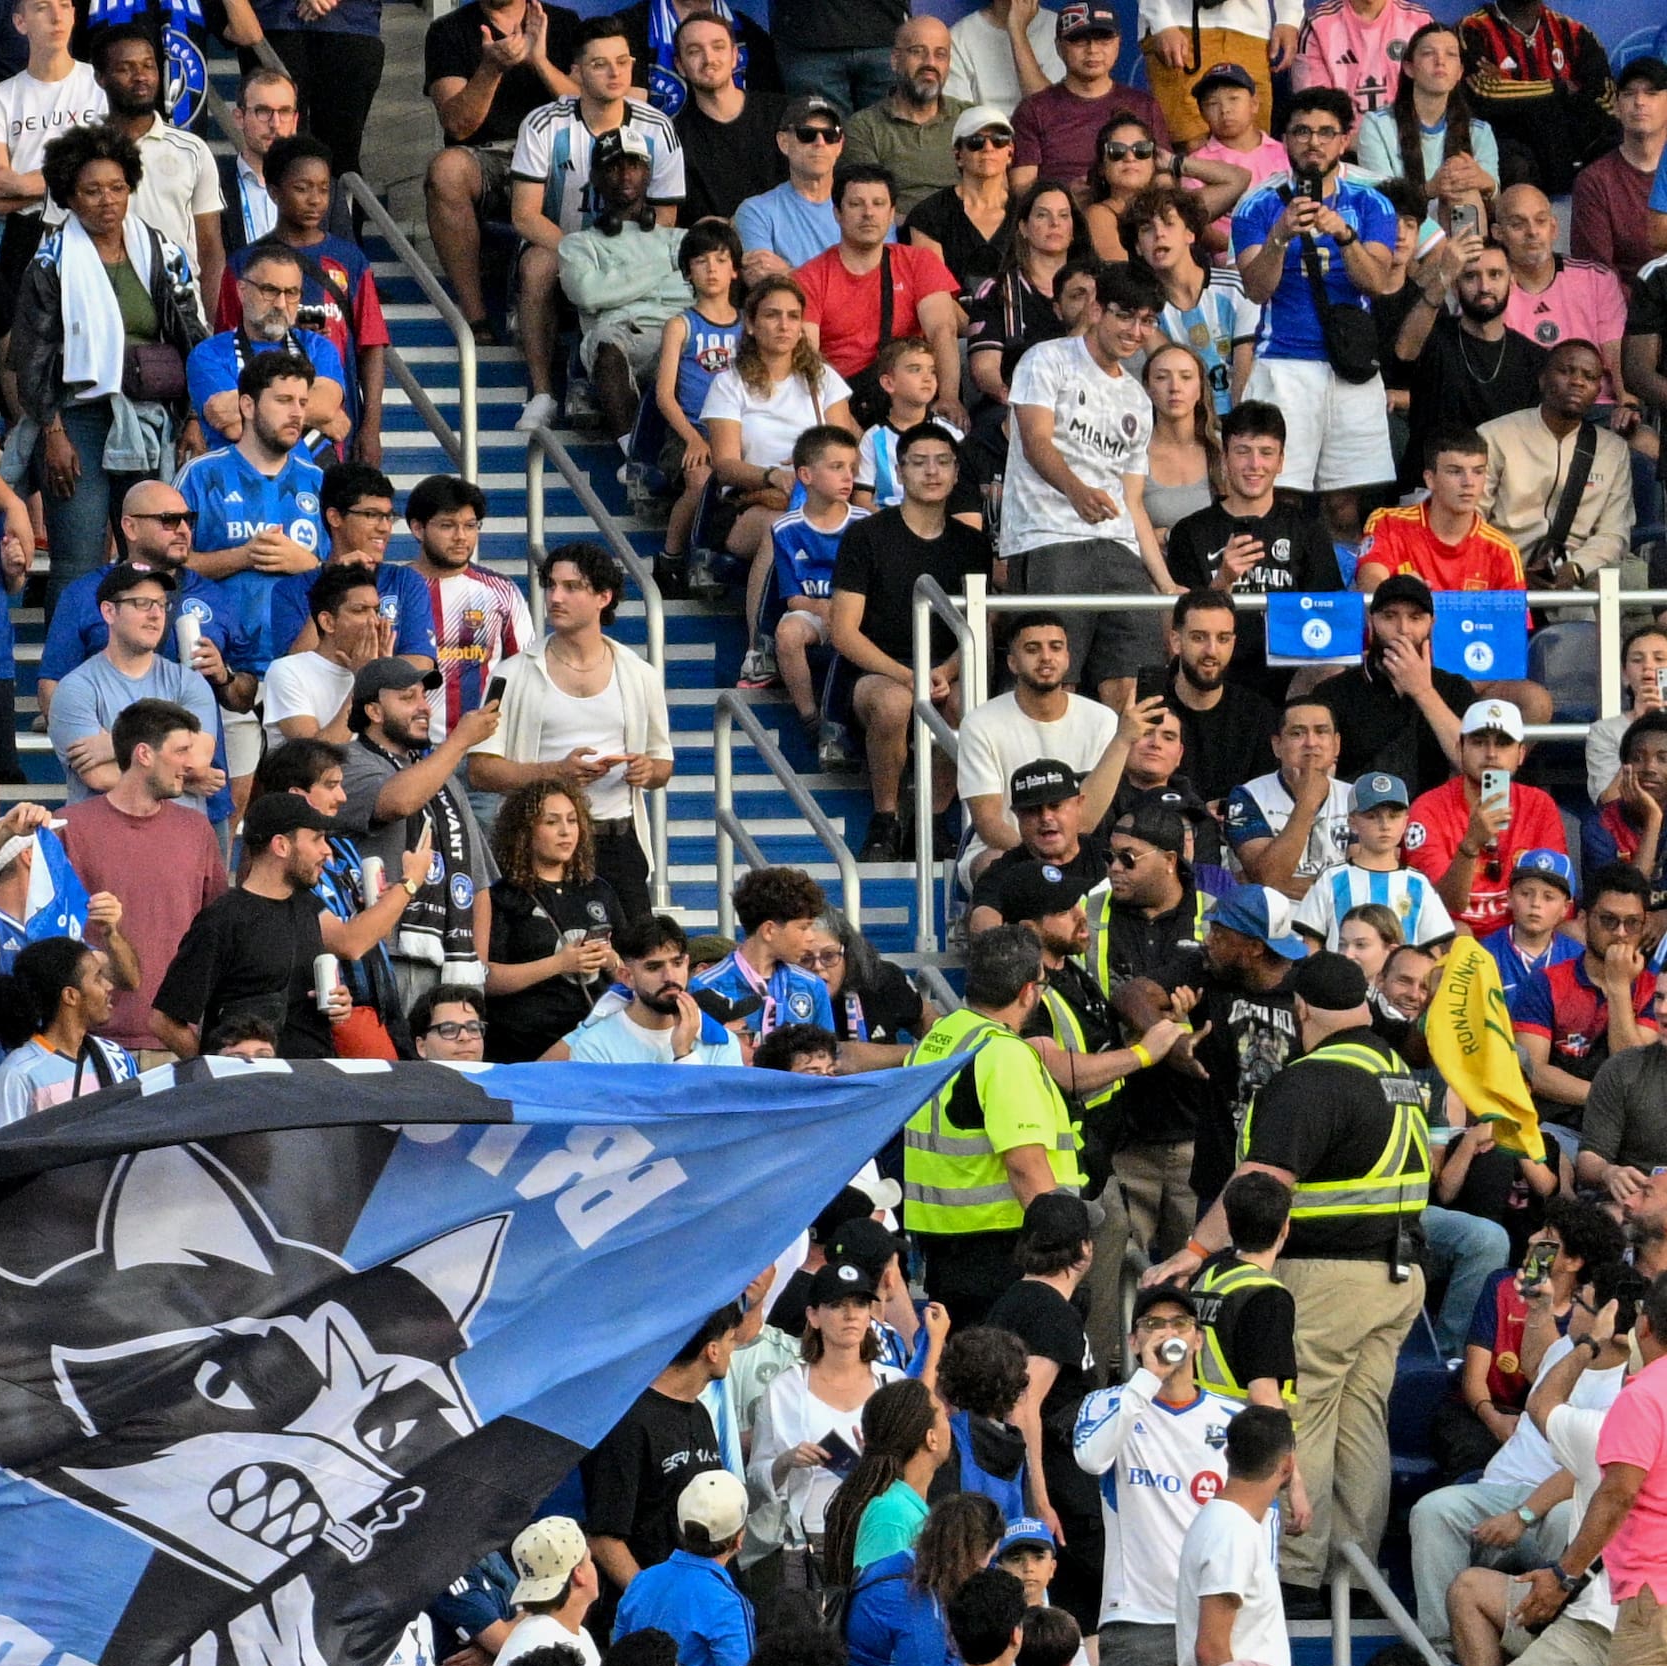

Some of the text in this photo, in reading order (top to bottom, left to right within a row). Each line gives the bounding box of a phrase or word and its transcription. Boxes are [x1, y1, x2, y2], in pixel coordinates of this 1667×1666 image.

[11, 109, 94, 137] DELUXE
[1069, 418, 1126, 458] MIAMI
[1128, 1467, 1182, 1493] BMO
